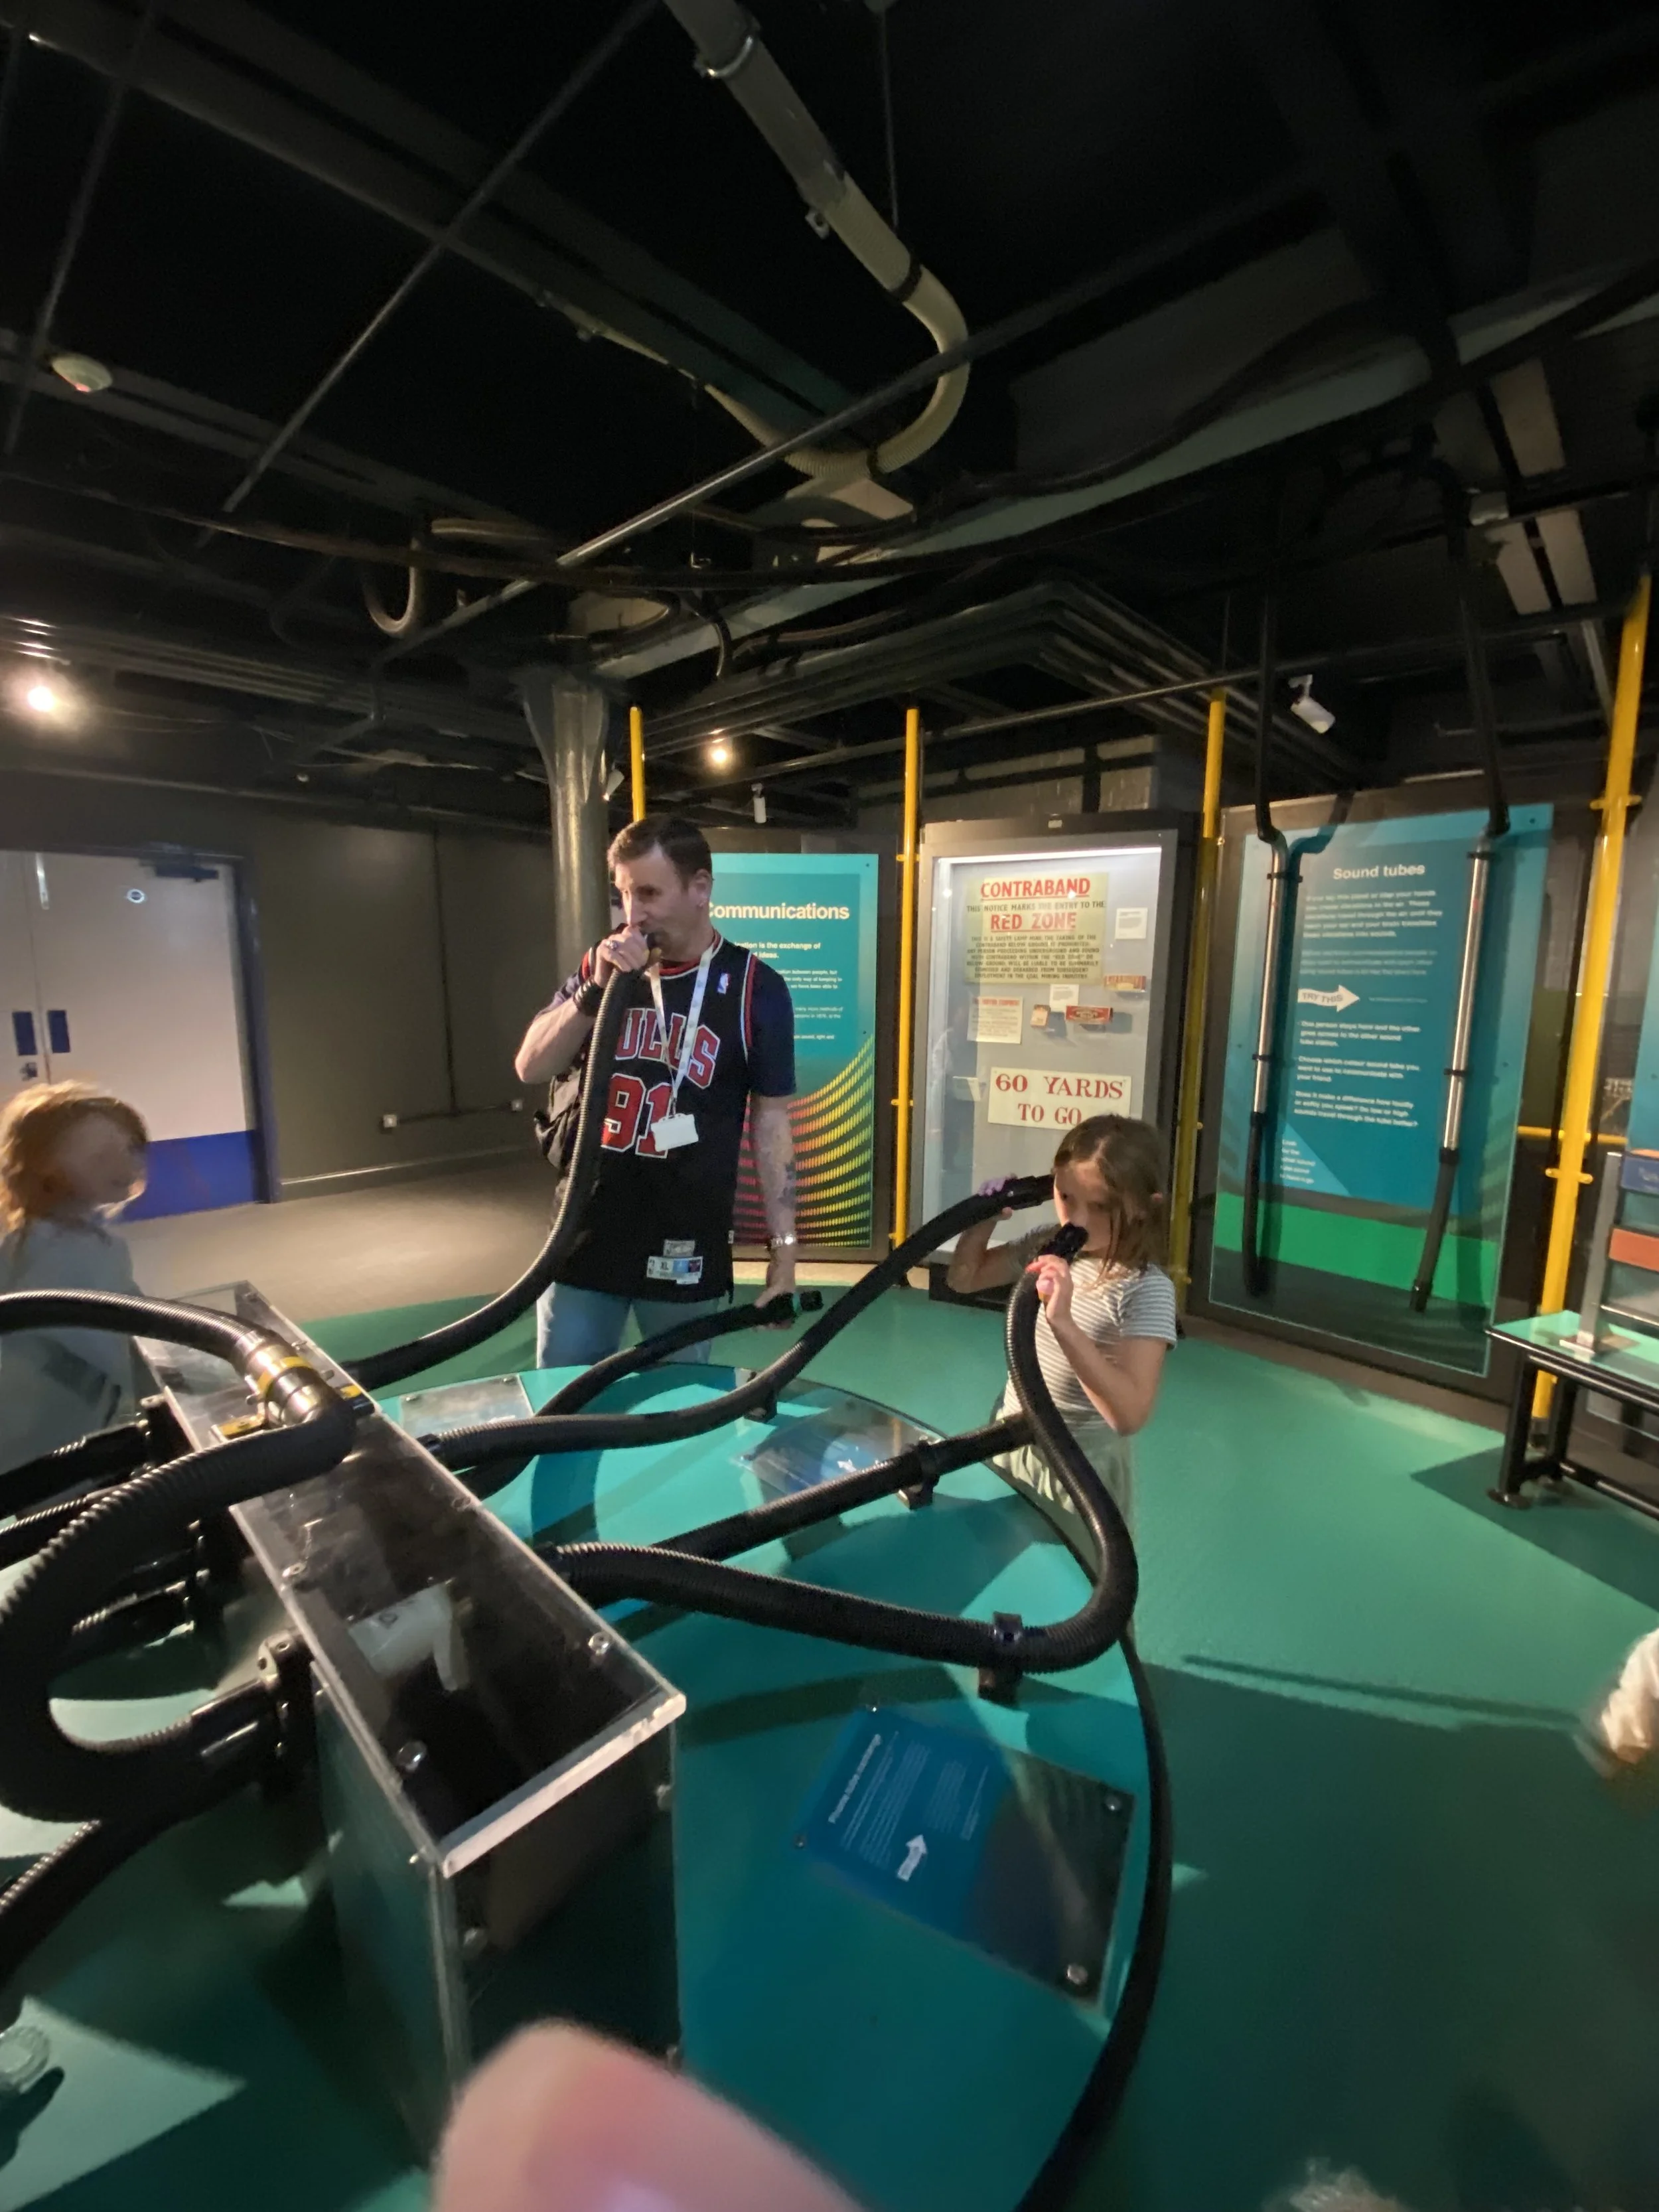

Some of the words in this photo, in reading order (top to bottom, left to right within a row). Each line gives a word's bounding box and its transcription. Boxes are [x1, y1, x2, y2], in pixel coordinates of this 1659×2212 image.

[1333, 865, 1380, 880] Sound
[1383, 864, 1425, 878] tubes
[980, 878, 1091, 897] CONTRABAND
[991, 913, 1023, 930] RED
[1031, 912, 1077, 928] ZONE
[779, 942, 812, 951] exchange
[1321, 994, 1344, 1003] THIS
[616, 1007, 721, 1090] ULLS
[996, 1073, 1028, 1092] 60
[1043, 1075, 1123, 1100] YARDS
[1018, 1103, 1045, 1122] TO
[1054, 1106, 1082, 1126] GO
